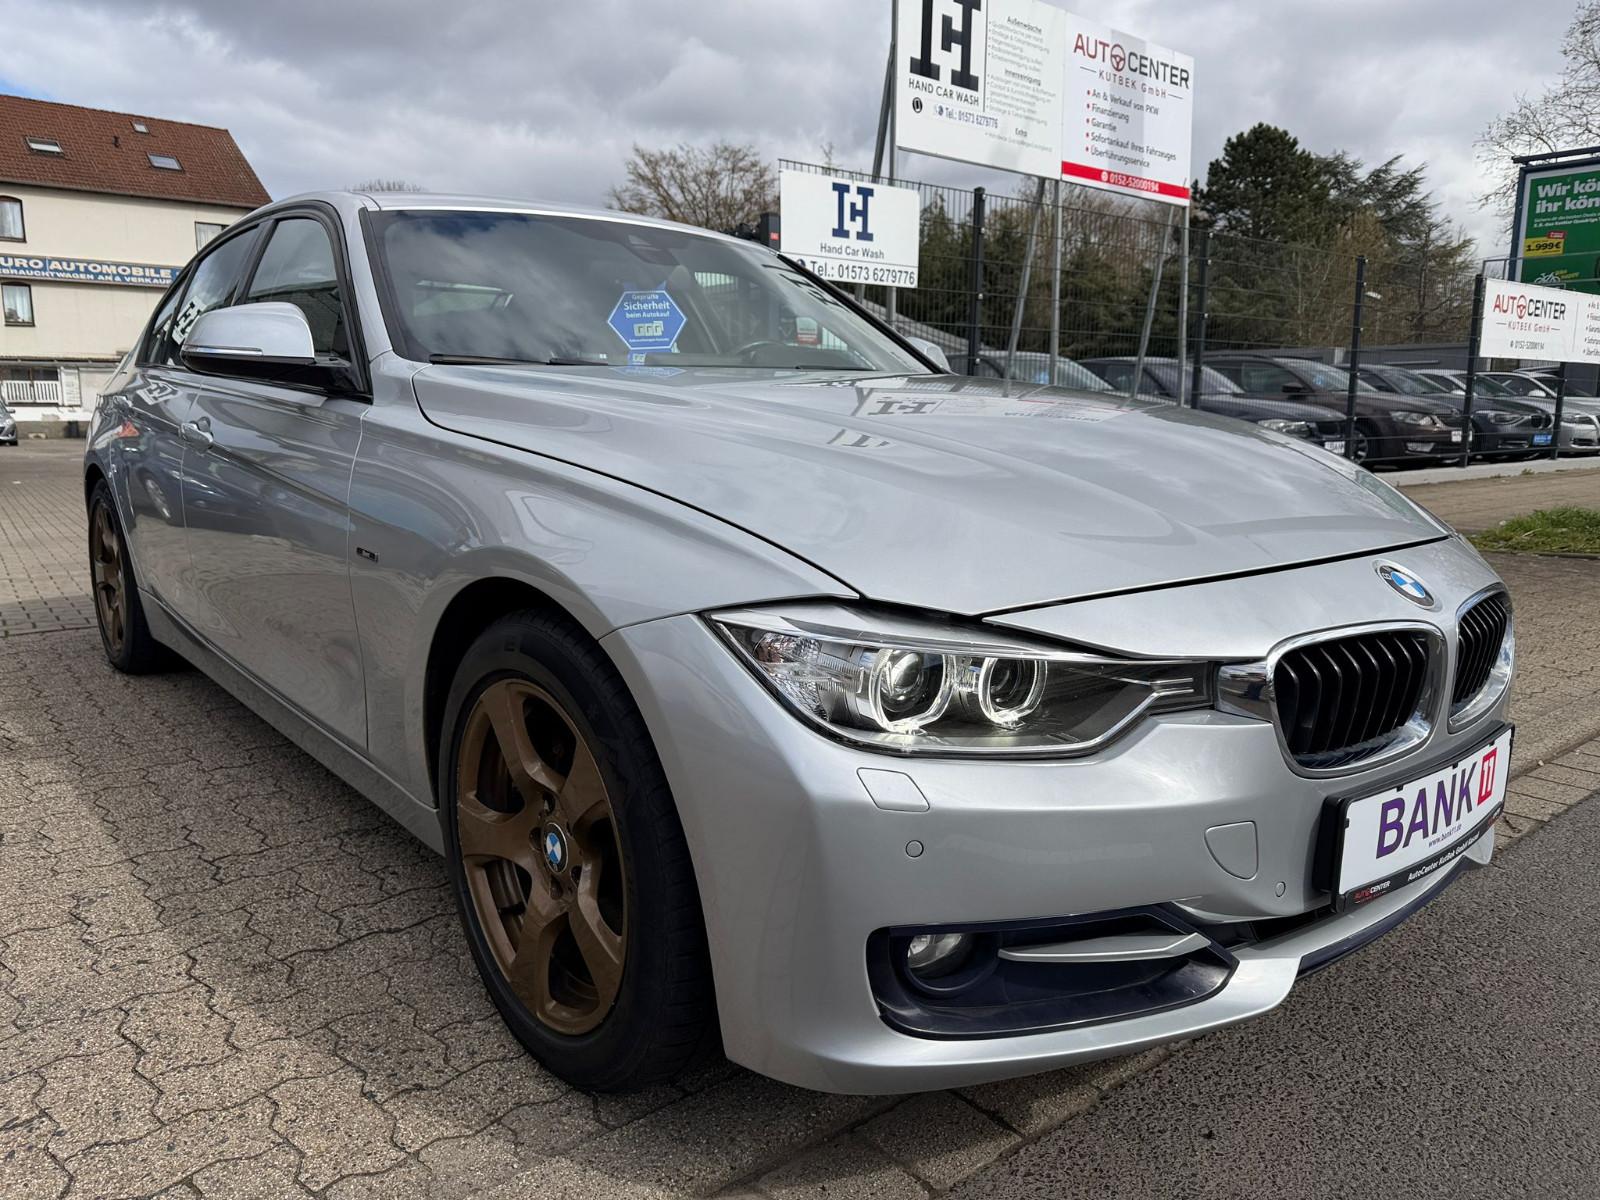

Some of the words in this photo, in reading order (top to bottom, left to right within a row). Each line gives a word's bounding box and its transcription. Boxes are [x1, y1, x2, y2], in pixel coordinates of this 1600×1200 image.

[909, 78, 933, 94] HAND
[936, 86, 954, 99] CAR
[956, 91, 979, 106] WASH
[1099, 70, 1137, 90] KUTBEK
[1141, 83, 1166, 98] GmbH
[1092, 89, 1101, 99] An
[1103, 92, 1109, 101] &
[1110, 94, 1132, 107] Verkauf
[1133, 102, 1144, 111] von
[1145, 104, 1159, 115] PKW
[1092, 103, 1129, 123] Finanzierung
[1091, 118, 1117, 132] Garantie
[1091, 132, 1129, 149] Sofortankauf
[1131, 142, 1145, 153] Ihres
[1146, 146, 1176, 161] Fahrzeuges
[1091, 145, 1150, 168] Überführungsservice
[1537, 183, 1571, 198] Wir
[1535, 200, 1562, 214] ihr
[820, 243, 842, 255] Hand
[844, 246, 859, 256] Car
[861, 247, 885, 259] Wash
[50, 261, 172, 279] AUTOMOBILE
[811, 261, 834, 277] Tel.:
[838, 264, 870, 281] 01573
[873, 267, 915, 285] 6279776
[623, 301, 670, 310] Sicherheit
[1407, 861, 1438, 881] AutoCenter
